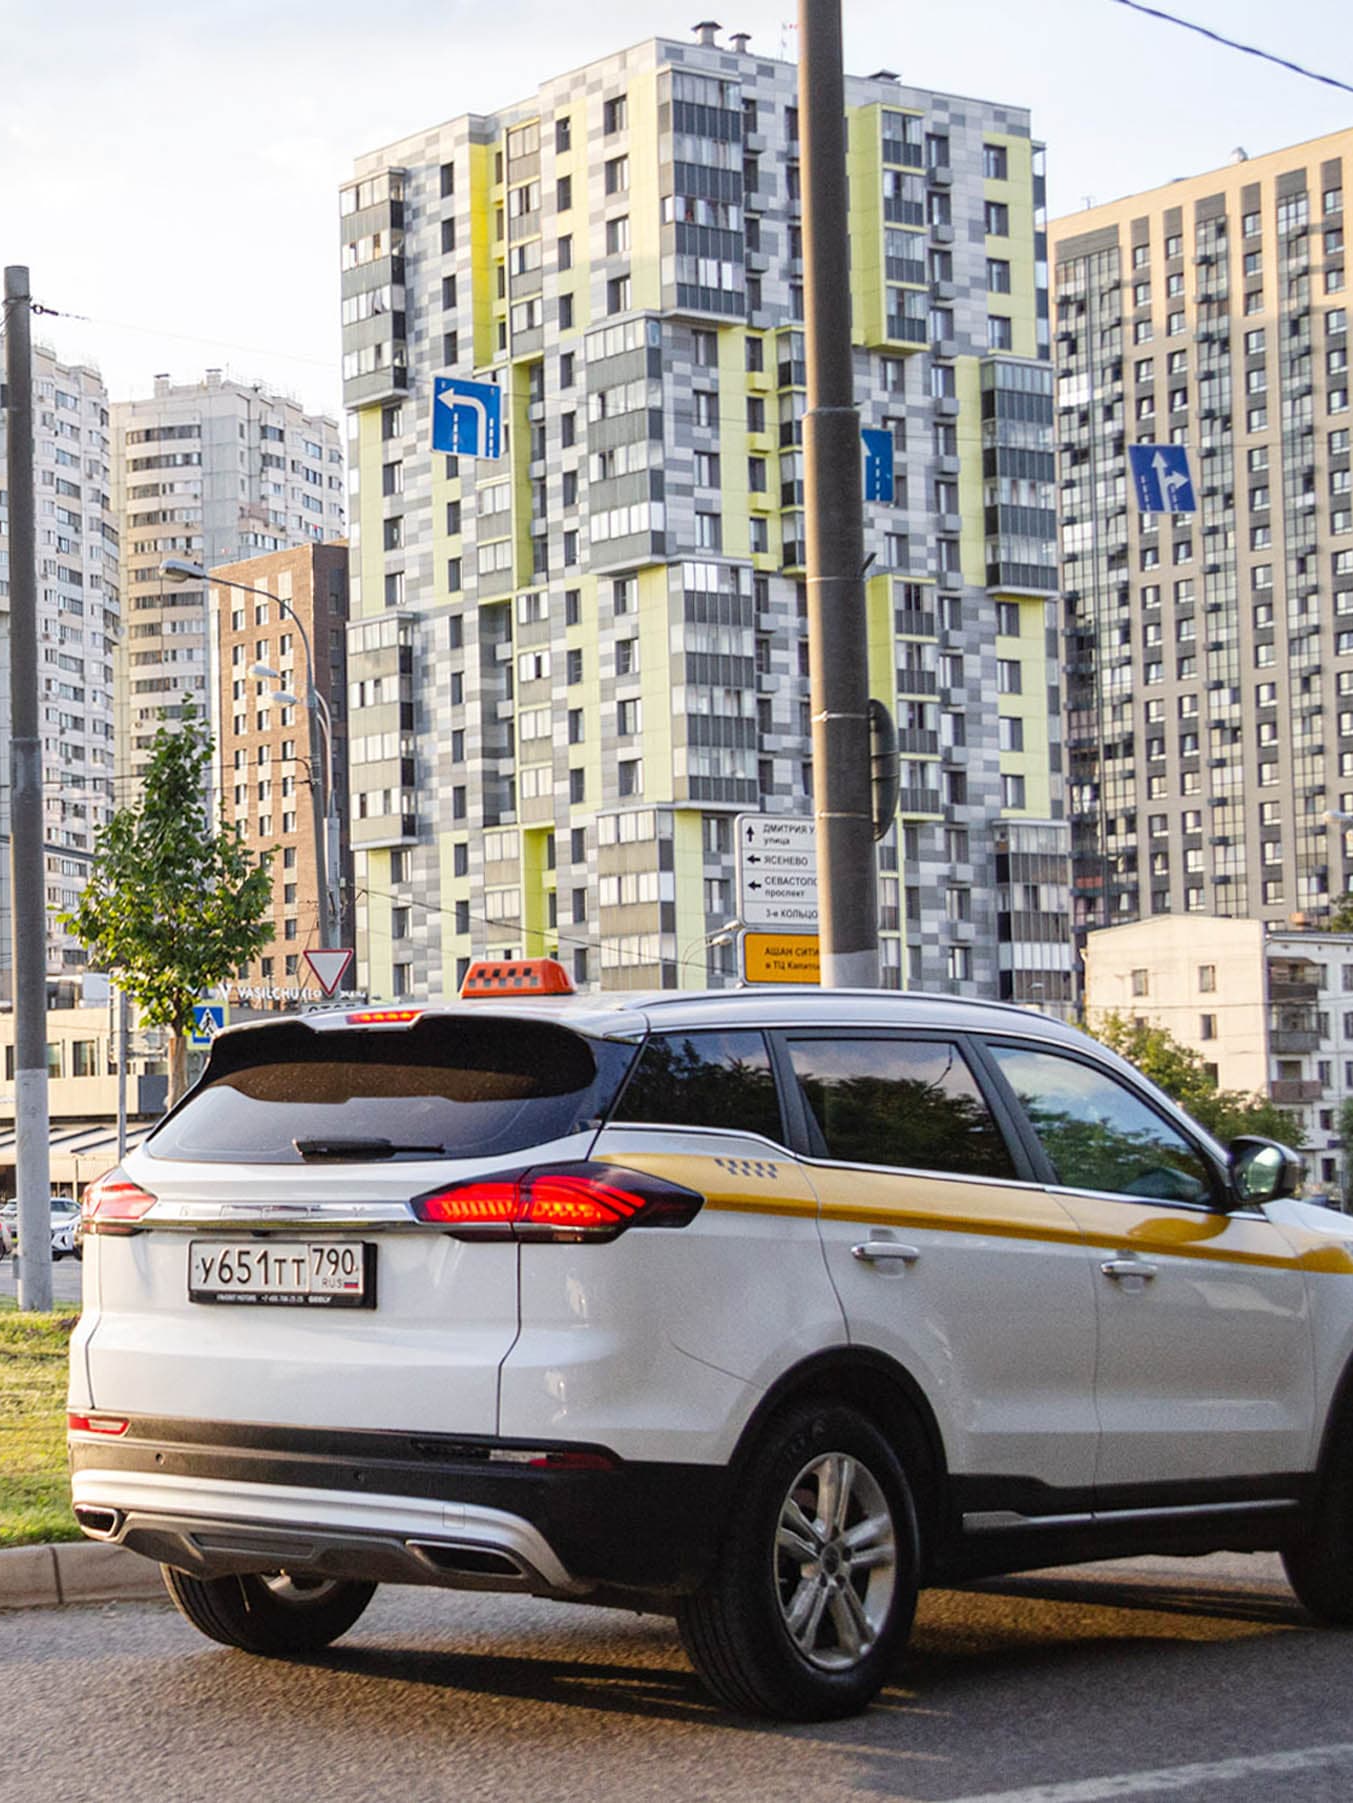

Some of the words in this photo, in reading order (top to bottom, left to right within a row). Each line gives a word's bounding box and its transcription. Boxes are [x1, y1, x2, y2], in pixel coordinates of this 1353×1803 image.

[763, 823, 808, 835] ДМИТРИЯ
[764, 838, 790, 847] улица
[764, 855, 809, 867] ЯСЕНЕВО
[765, 889, 805, 899] проспект
[780, 908, 818, 921] КОЛЬЦО
[764, 946, 792, 956] АШАН
[773, 960, 785, 971] ТЦ
[312, 1248, 355, 1276] 790
[321, 1278, 343, 1289] RUS
